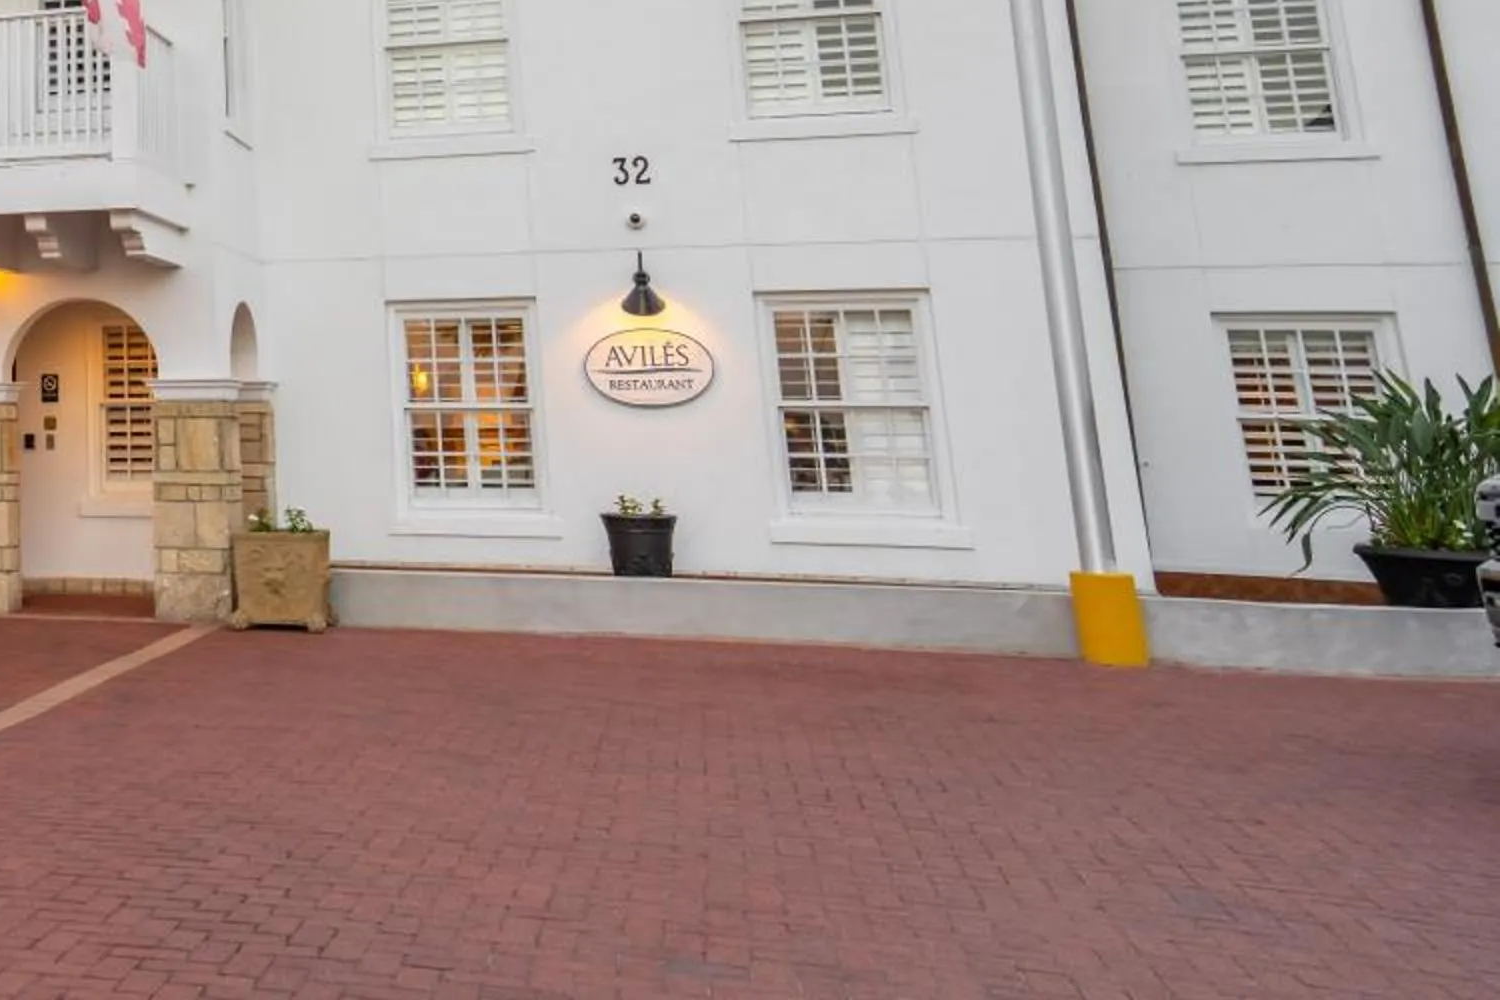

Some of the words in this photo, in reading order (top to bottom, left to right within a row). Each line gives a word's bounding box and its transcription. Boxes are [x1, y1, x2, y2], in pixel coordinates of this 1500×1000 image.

[612, 155, 651, 186] 32
[605, 340, 690, 367] AVILÉS
[609, 378, 695, 391] RESTAURANT
